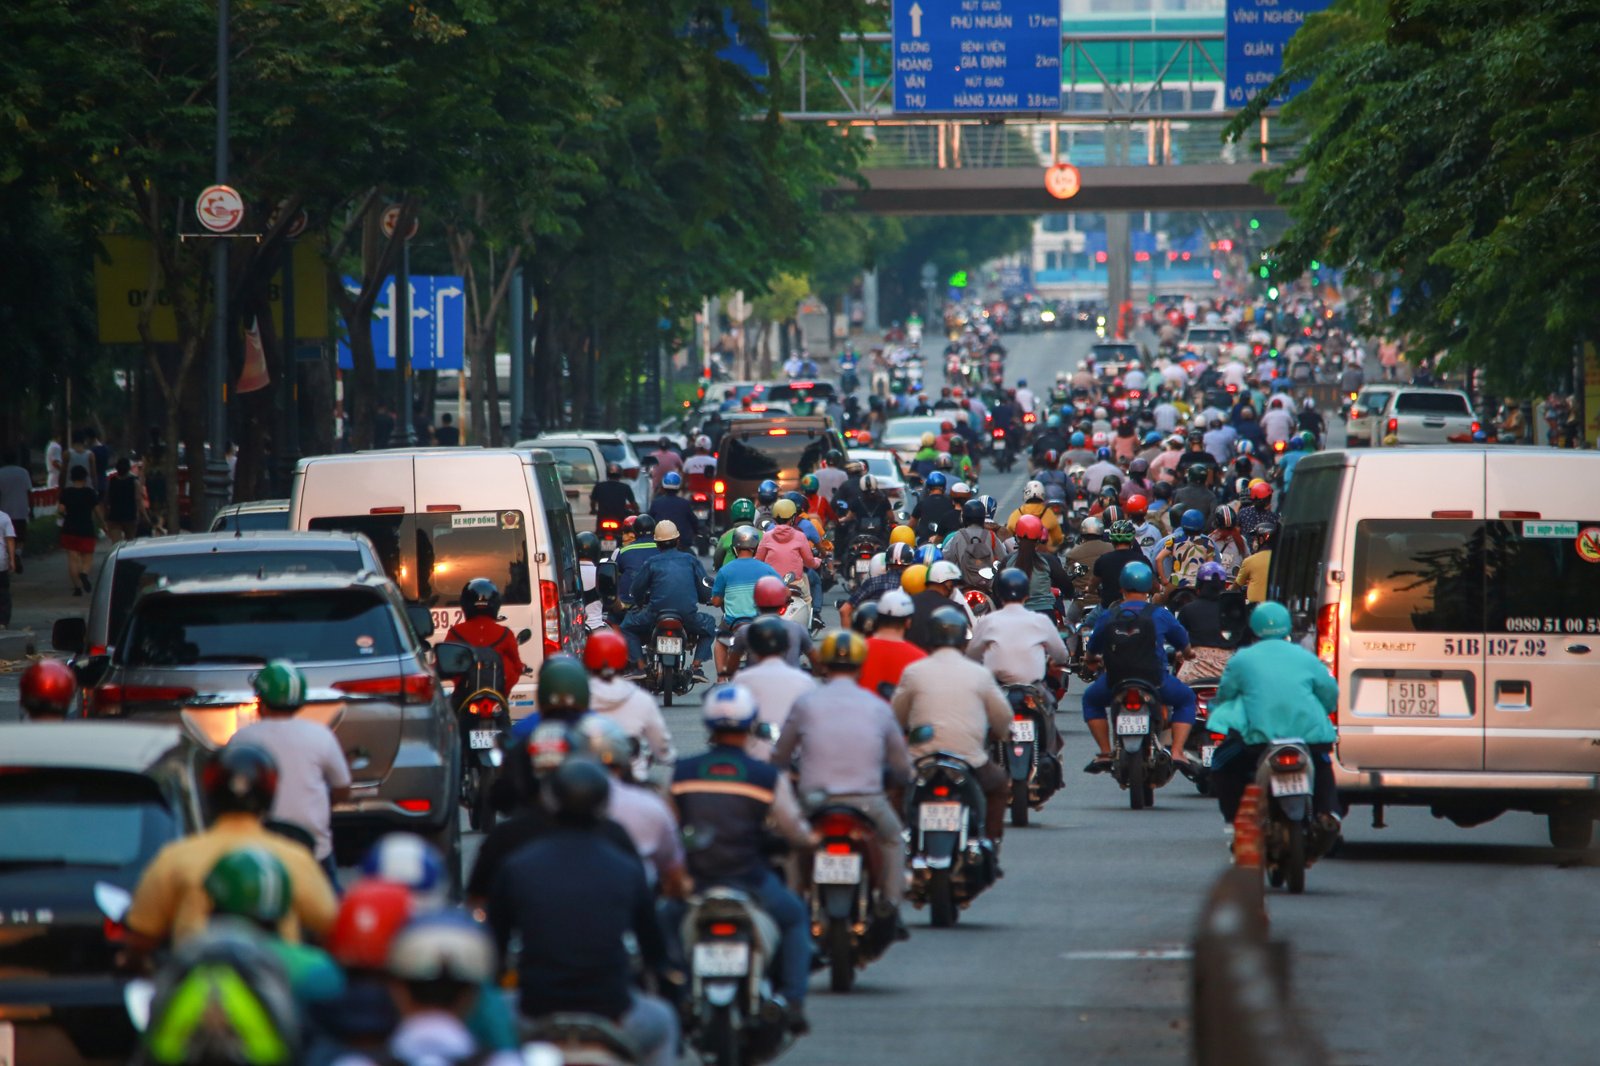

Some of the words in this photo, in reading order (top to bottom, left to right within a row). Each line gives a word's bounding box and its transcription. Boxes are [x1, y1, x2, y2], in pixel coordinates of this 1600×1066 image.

[960, 56, 978, 68] GIA
[987, 93, 1018, 107] XANH
[1526, 526, 1534, 534] XE
[1506, 618, 1541, 631] 0989
[1543, 618, 1560, 631] 51
[1566, 618, 1583, 632] 00
[1444, 639, 1479, 656] 51B
[1488, 639, 1547, 656] 197.92
[1400, 683, 1426, 698] 51B
[1391, 700, 1437, 714] 197.92
